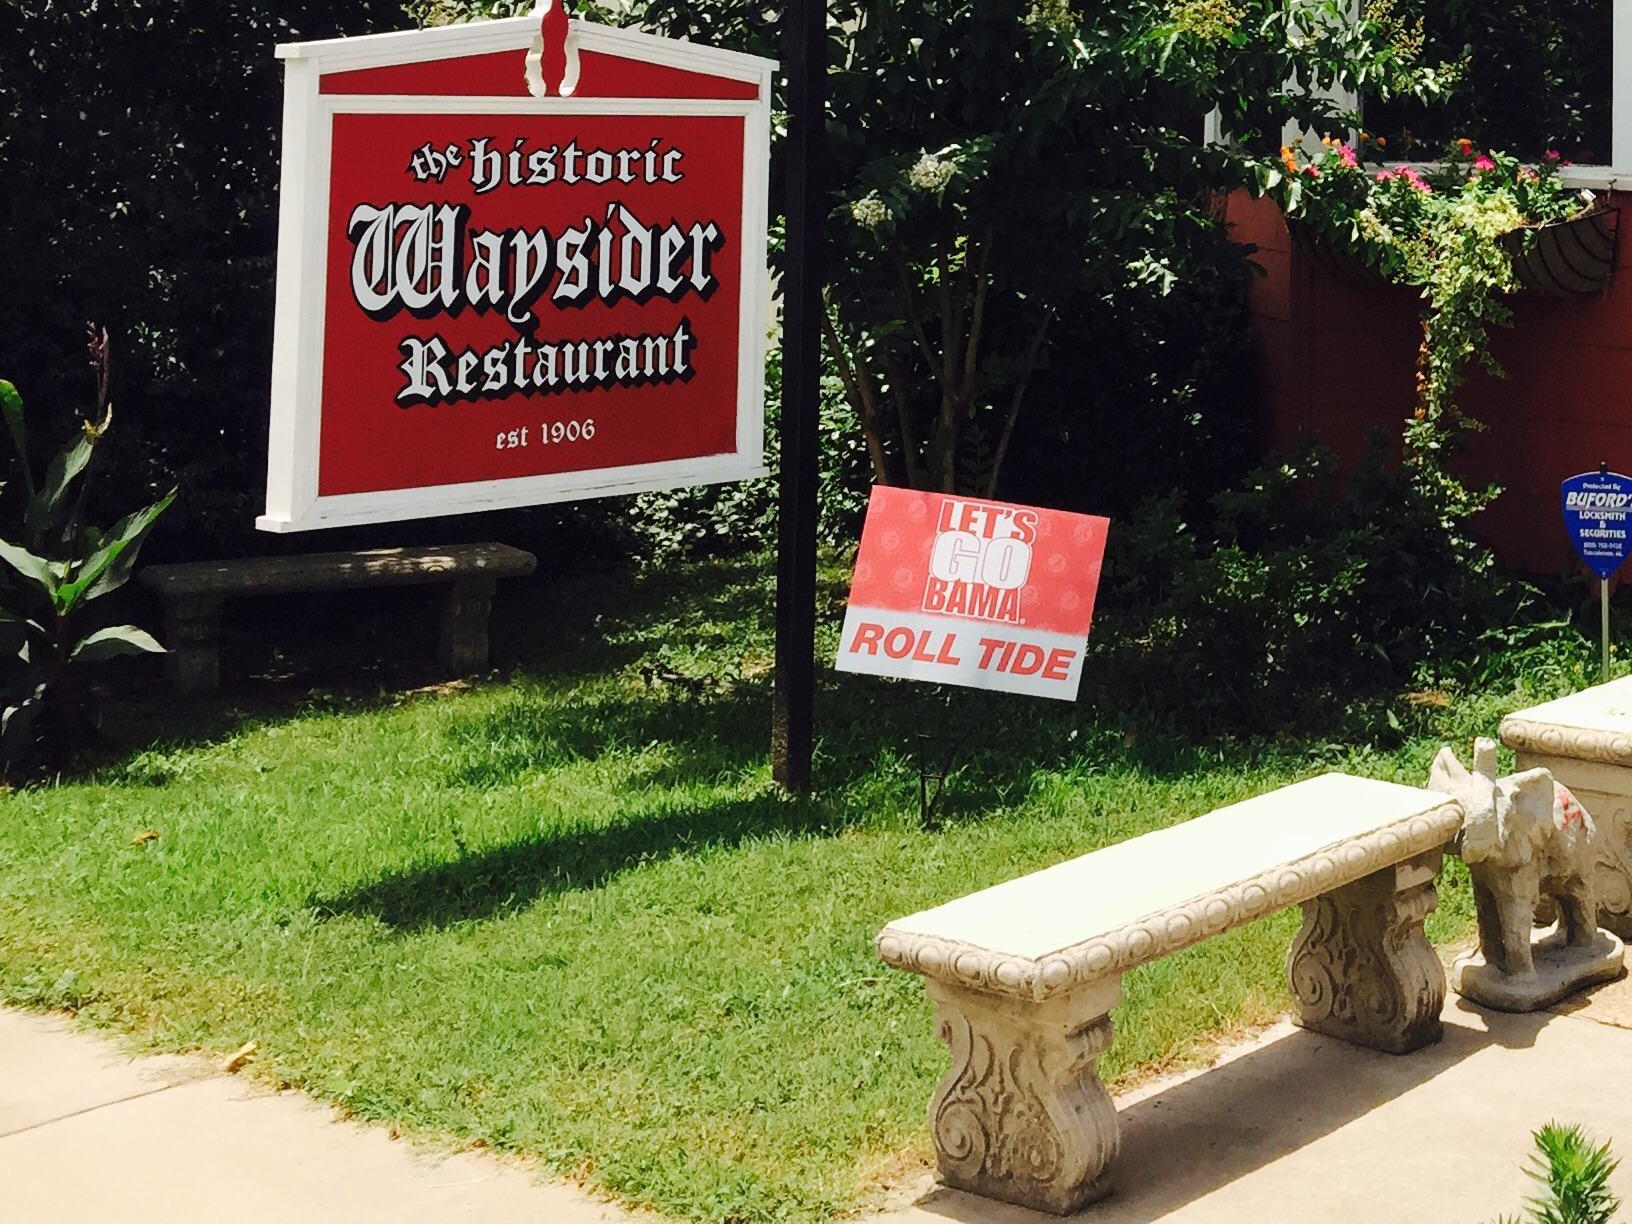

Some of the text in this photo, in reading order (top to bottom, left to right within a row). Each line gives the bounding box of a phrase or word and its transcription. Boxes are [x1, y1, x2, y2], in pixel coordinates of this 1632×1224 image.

[411, 142, 463, 181] the
[348, 202, 719, 323] Waysider
[396, 325, 690, 400] Restaurant
[495, 418, 596, 449] est 1906
[938, 500, 1038, 543] LET'S
[1579, 511, 1626, 521] LOCKSMITH
[1580, 529, 1626, 538] SECURITIES
[931, 530, 1031, 590] GO
[850, 623, 1077, 681] ROLL TIDE
